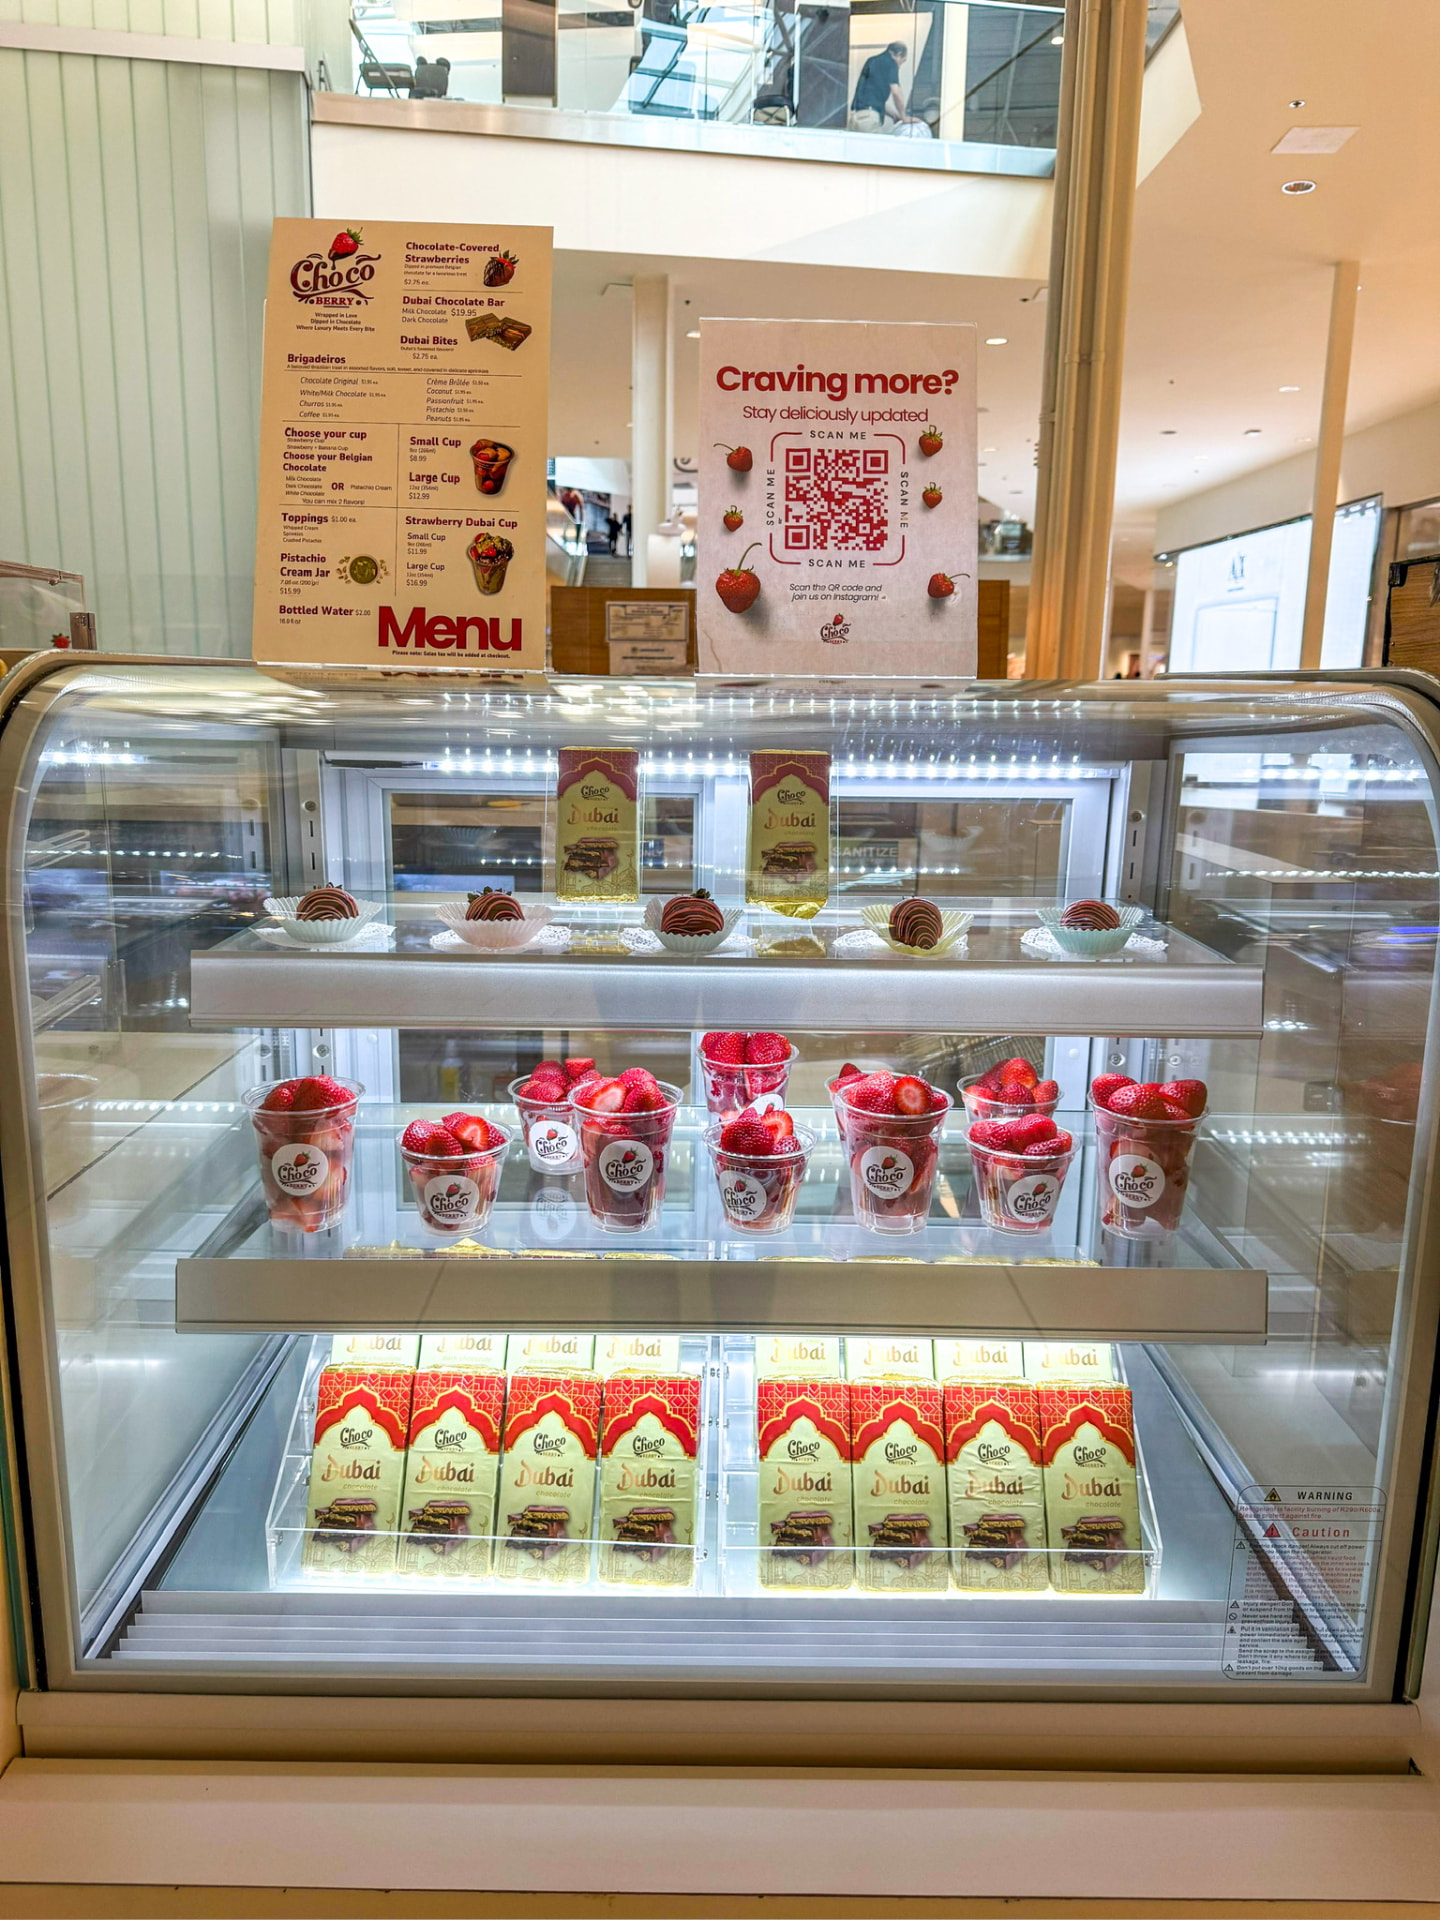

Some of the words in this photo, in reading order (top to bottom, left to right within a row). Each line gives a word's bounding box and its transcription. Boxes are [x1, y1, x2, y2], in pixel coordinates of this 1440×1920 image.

[406, 242, 499, 252] Chocolate-Covered
[405, 254, 469, 264] Strawberries
[290, 260, 375, 292] Choco
[316, 297, 354, 305] BERRY
[403, 296, 431, 305] Dubai
[435, 297, 484, 306] Chocolate
[488, 298, 505, 307] Bar
[400, 336, 429, 344] Dubai
[433, 336, 458, 345] Bites
[288, 354, 346, 364] Brigadeiros
[334, 378, 358, 386] Original
[449, 378, 470, 386] Brûlée
[717, 364, 848, 401] Craving
[855, 369, 959, 395] more?
[336, 390, 367, 398] Chocolate
[743, 406, 777, 422] Stay
[780, 406, 858, 425] deliciously
[861, 408, 928, 425] updated
[285, 427, 320, 437] Choose
[324, 431, 346, 439] your
[349, 431, 367, 440] cup
[810, 430, 843, 439] SCAN
[410, 437, 439, 446] Small
[442, 438, 461, 448] Cup
[284, 452, 314, 460] Choose
[340, 453, 372, 462] Belgian
[283, 463, 326, 471] Chocolate
[409, 472, 438, 484] Large
[441, 473, 460, 485] Cup
[767, 469, 775, 486] ME
[900, 472, 908, 505] SCAN
[282, 513, 328, 524] Toppings
[406, 516, 462, 527] Strawberry
[466, 518, 495, 527] Dubai
[498, 519, 518, 529] Cup
[408, 532, 428, 540] Small
[431, 533, 446, 542] Cup
[280, 553, 326, 562] Pistachio
[809, 559, 842, 567] SCAN
[849, 560, 865, 568] ME
[280, 567, 312, 577] Cream
[315, 568, 330, 577] Jar
[407, 562, 428, 571] Large
[792, 593, 806, 602] join
[834, 594, 879, 603] Instagram!
[279, 605, 318, 614] Bottled
[322, 607, 353, 615] Water
[378, 606, 522, 651] Menu
[820, 625, 849, 638] Choco
[581, 785, 609, 796] Choco
[777, 789, 805, 801] Choco
[567, 804, 619, 825] Dubai
[764, 808, 816, 829] Dubai
[831, 846, 898, 857] SANITIZE
[536, 1140, 567, 1153] Choco
[278, 1165, 317, 1181] Choco
[606, 1162, 643, 1177] Choco
[866, 1166, 903, 1181] Choco
[1115, 1174, 1154, 1190] Choco
[430, 1194, 468, 1210] Choco
[1014, 1194, 1050, 1210] Choco
[770, 1339, 825, 1363] Dubai
[340, 1427, 372, 1444] Choco
[435, 1429, 467, 1445] Choco
[534, 1433, 566, 1450] Choco
[633, 1435, 665, 1452] Choco
[788, 1440, 820, 1456] Choco
[885, 1442, 917, 1458] Choco
[978, 1444, 1010, 1459] Choco
[1074, 1446, 1106, 1462] Choco
[322, 1454, 380, 1482] Dubai
[416, 1456, 474, 1483] Dubai
[514, 1460, 573, 1487] Dubai
[617, 1463, 676, 1490] Dubai
[773, 1467, 832, 1495] Dubai
[871, 1470, 930, 1496] Dubai
[965, 1470, 1024, 1500] Dubai
[1062, 1472, 1122, 1500] Dubai
[1298, 1491, 1353, 1500] WARNING
[1292, 1527, 1350, 1537] Caution
